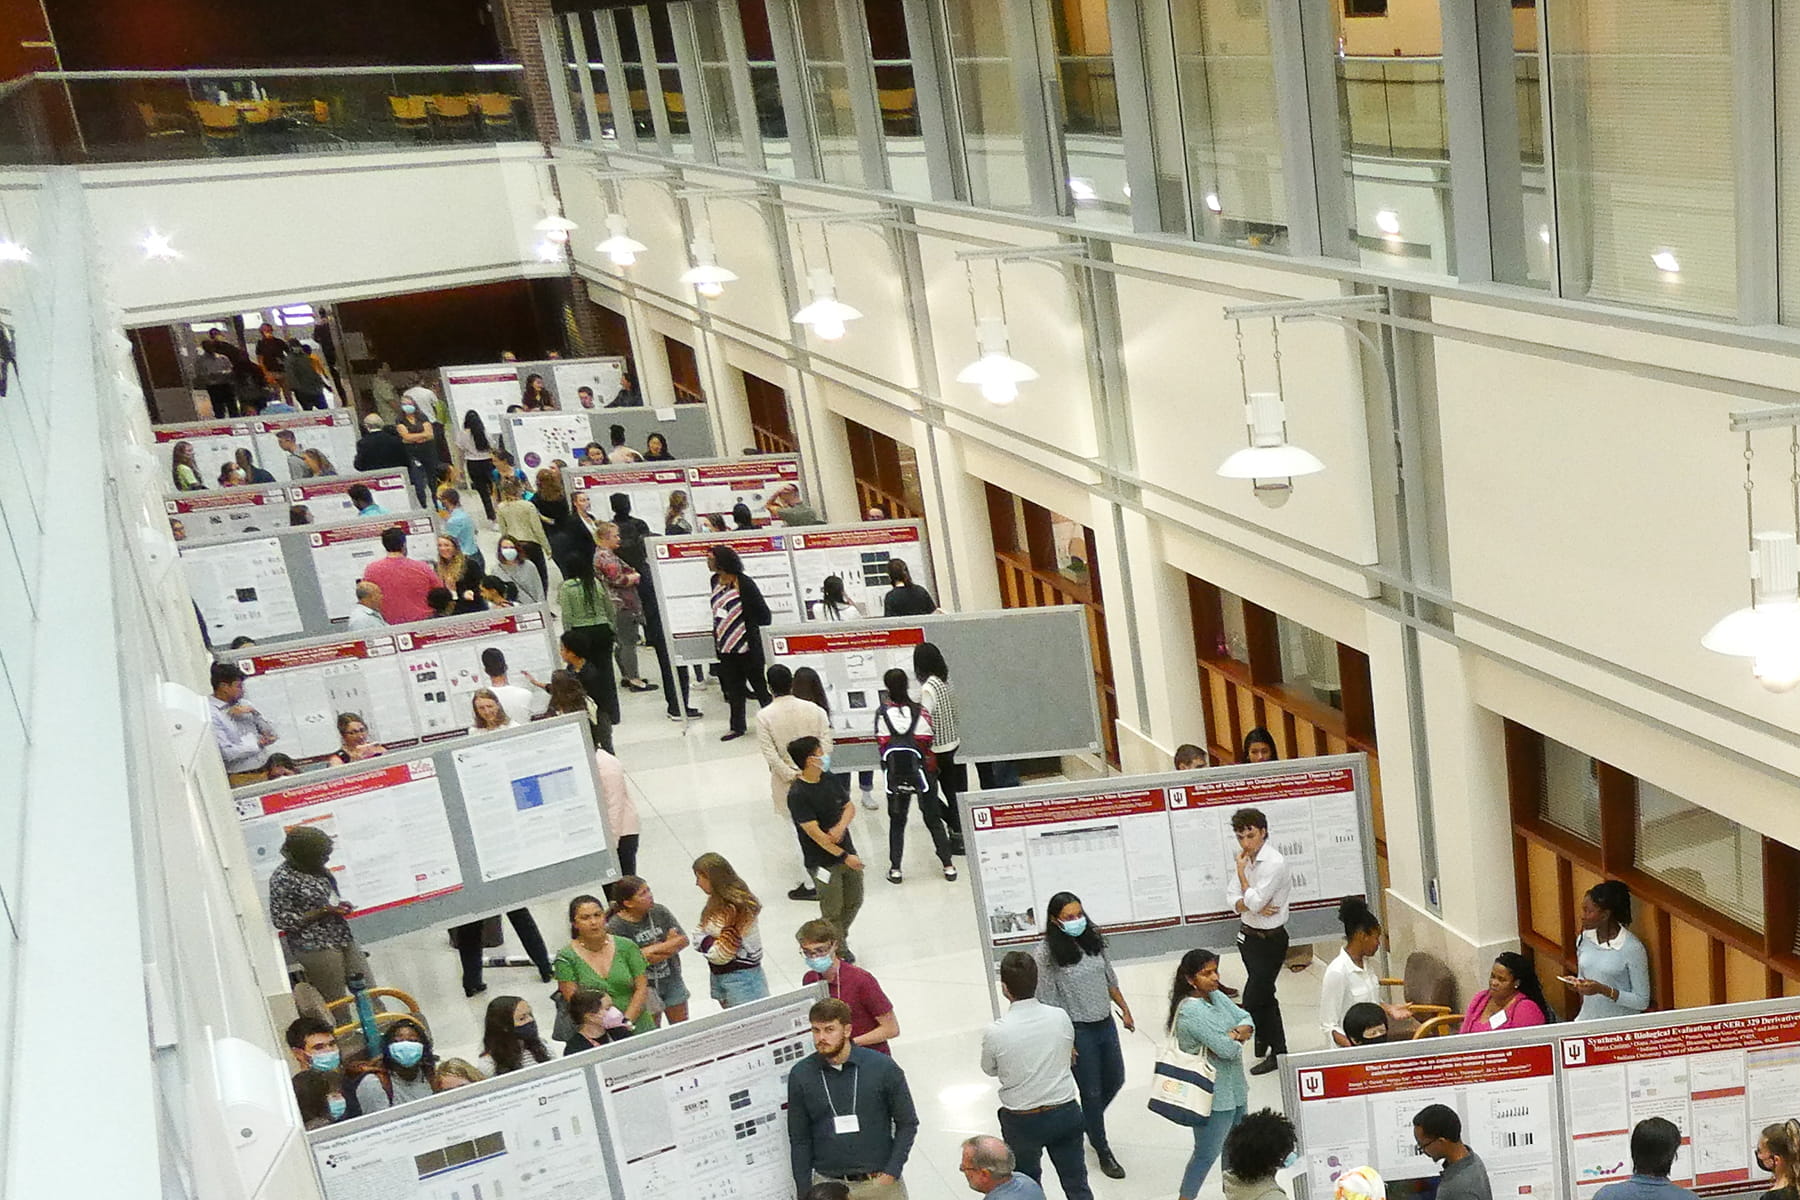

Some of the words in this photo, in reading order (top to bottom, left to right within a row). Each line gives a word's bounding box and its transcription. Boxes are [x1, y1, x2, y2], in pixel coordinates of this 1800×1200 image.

[1587, 1034, 1622, 1046] Synthesis
[1633, 1029, 1670, 1040] Biological
[1671, 1023, 1711, 1034] Evaluation
[1720, 1019, 1744, 1029] NERx
[1746, 1018, 1760, 1026] 329
[1761, 1012, 1800, 1024] Derivatives
